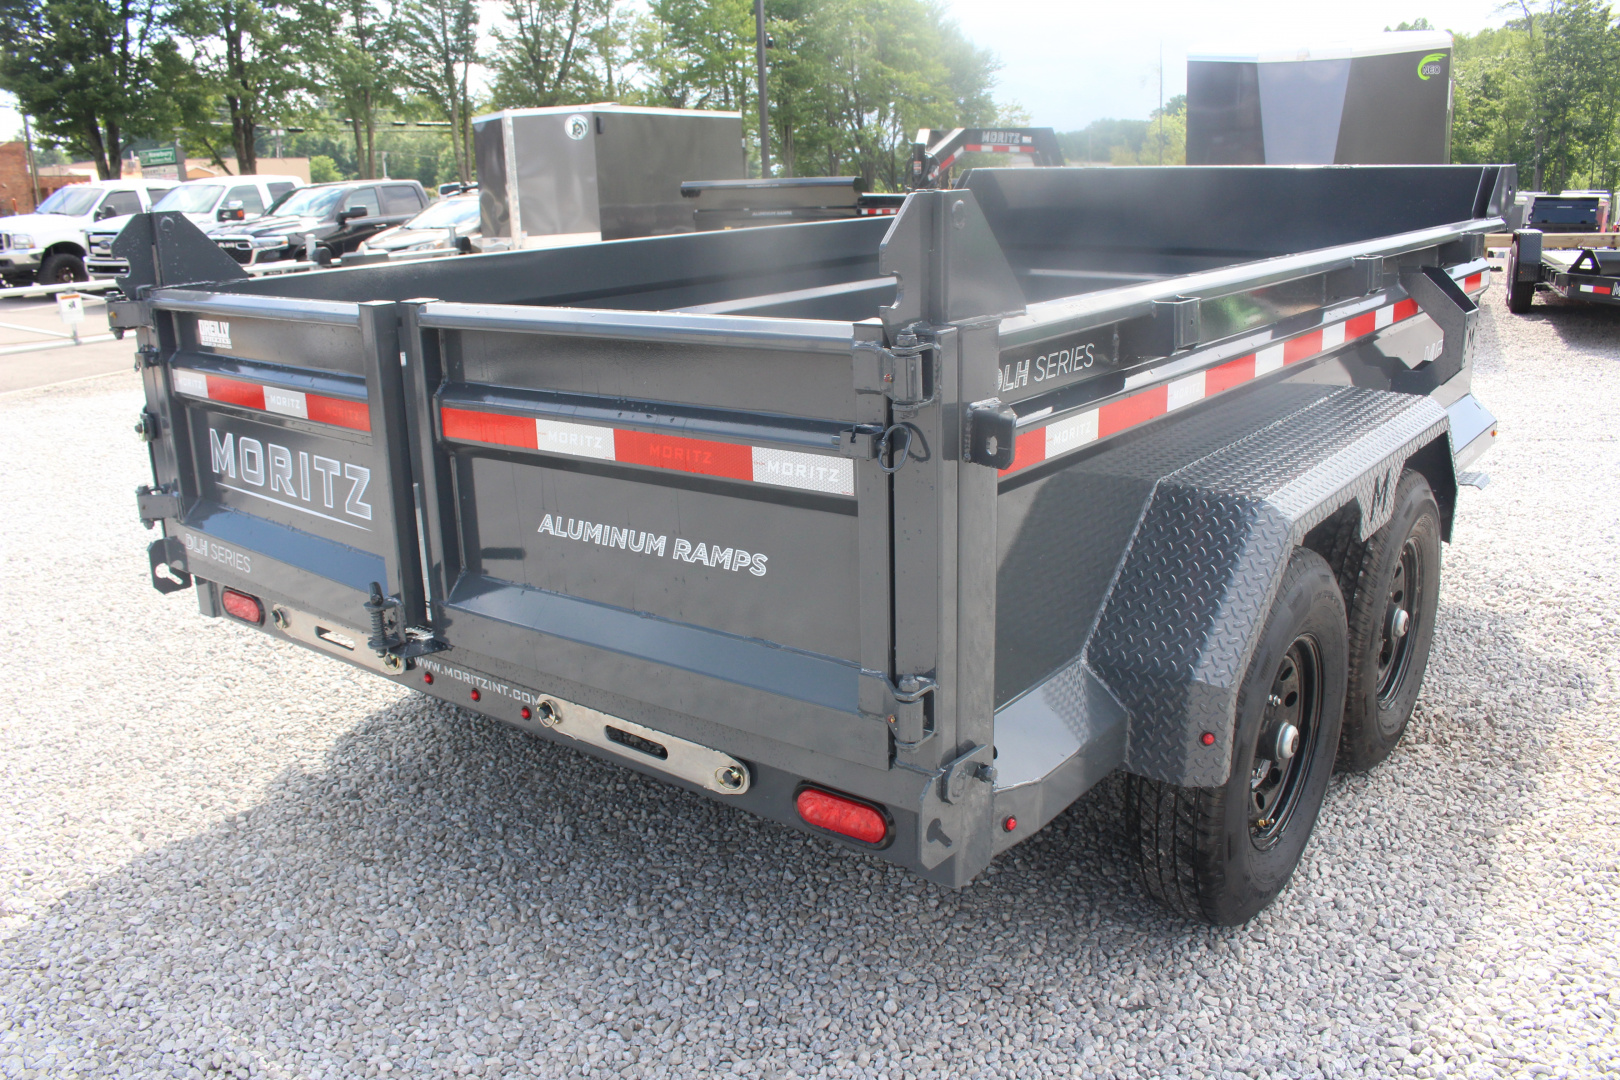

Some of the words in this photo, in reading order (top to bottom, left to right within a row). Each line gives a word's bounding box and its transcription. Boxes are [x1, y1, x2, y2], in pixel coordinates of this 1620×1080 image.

[981, 131, 1020, 144] MORITZ
[1034, 343, 1095, 382] SERIES
[269, 394, 301, 410] MORITZ
[547, 430, 603, 450] MORITZ
[1053, 421, 1091, 446] MORITZ
[649, 444, 713, 465] MORITZ
[209, 427, 372, 521] MORITZ
[767, 458, 839, 482] MORITZ
[185, 533, 208, 557] DLH
[210, 543, 251, 573] SERIES
[537, 513, 666, 556] ALUMINUM
[672, 538, 769, 577] RAMPS
[414, 656, 540, 706] WWW.MORITZINT.COM
